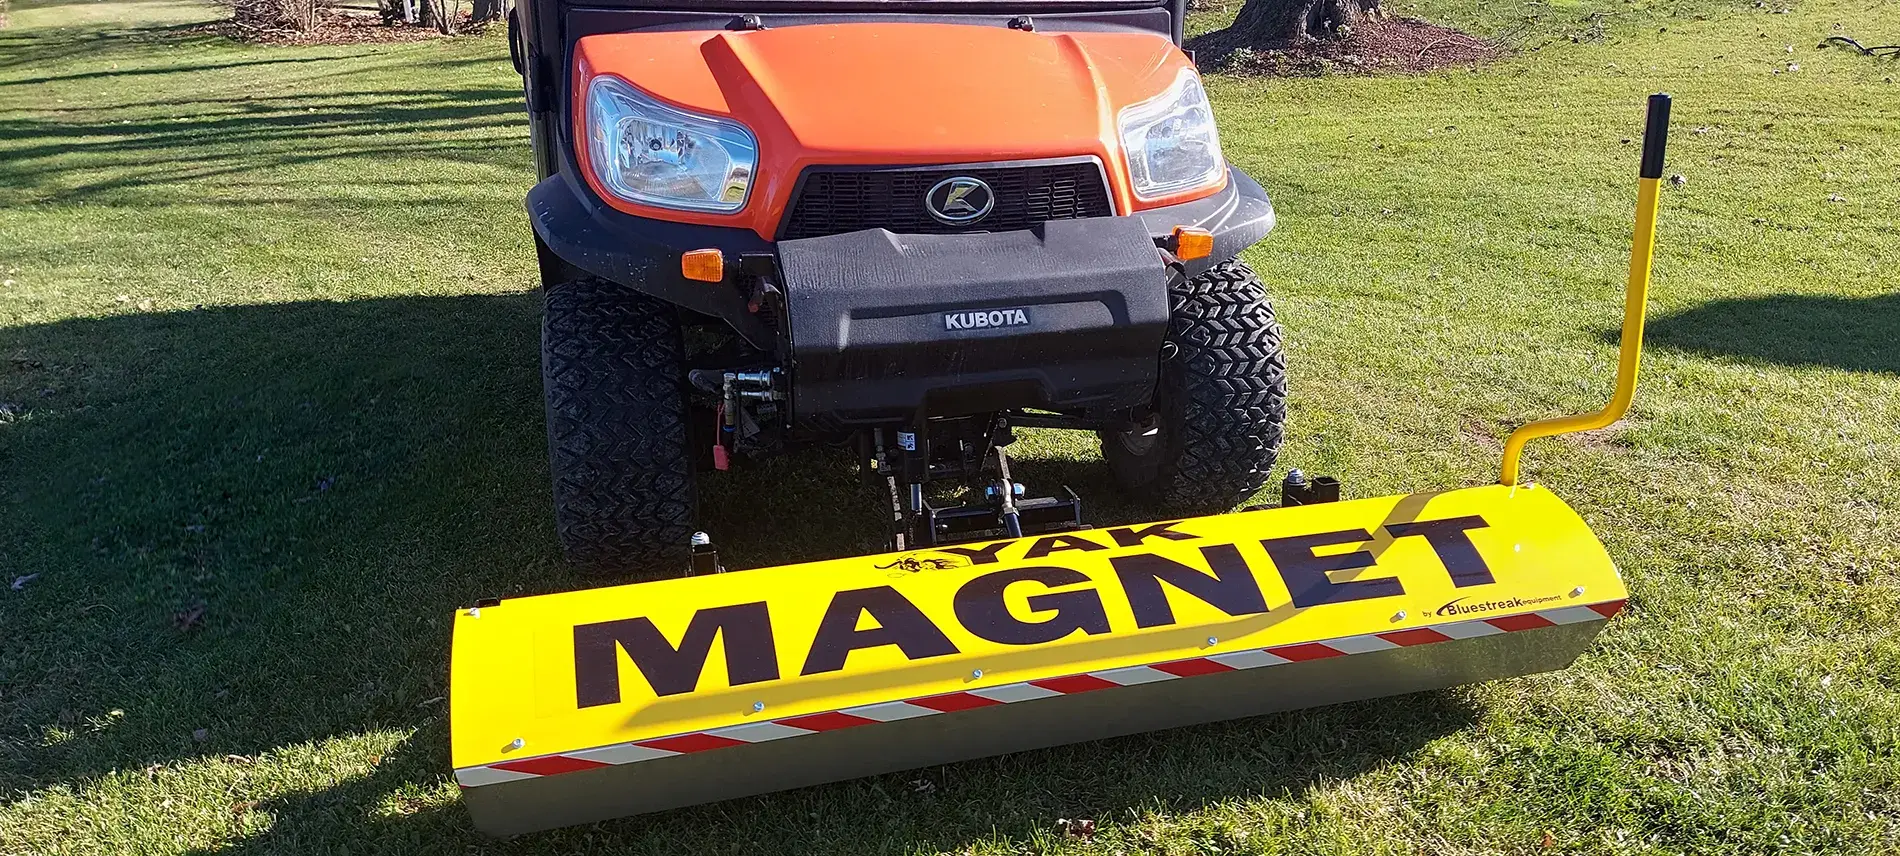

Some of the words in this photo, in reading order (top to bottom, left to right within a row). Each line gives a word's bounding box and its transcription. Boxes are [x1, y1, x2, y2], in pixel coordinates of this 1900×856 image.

[944, 309, 1029, 330] KUBOTA
[943, 521, 1204, 566] YAK
[575, 514, 1496, 708] MAGNET
